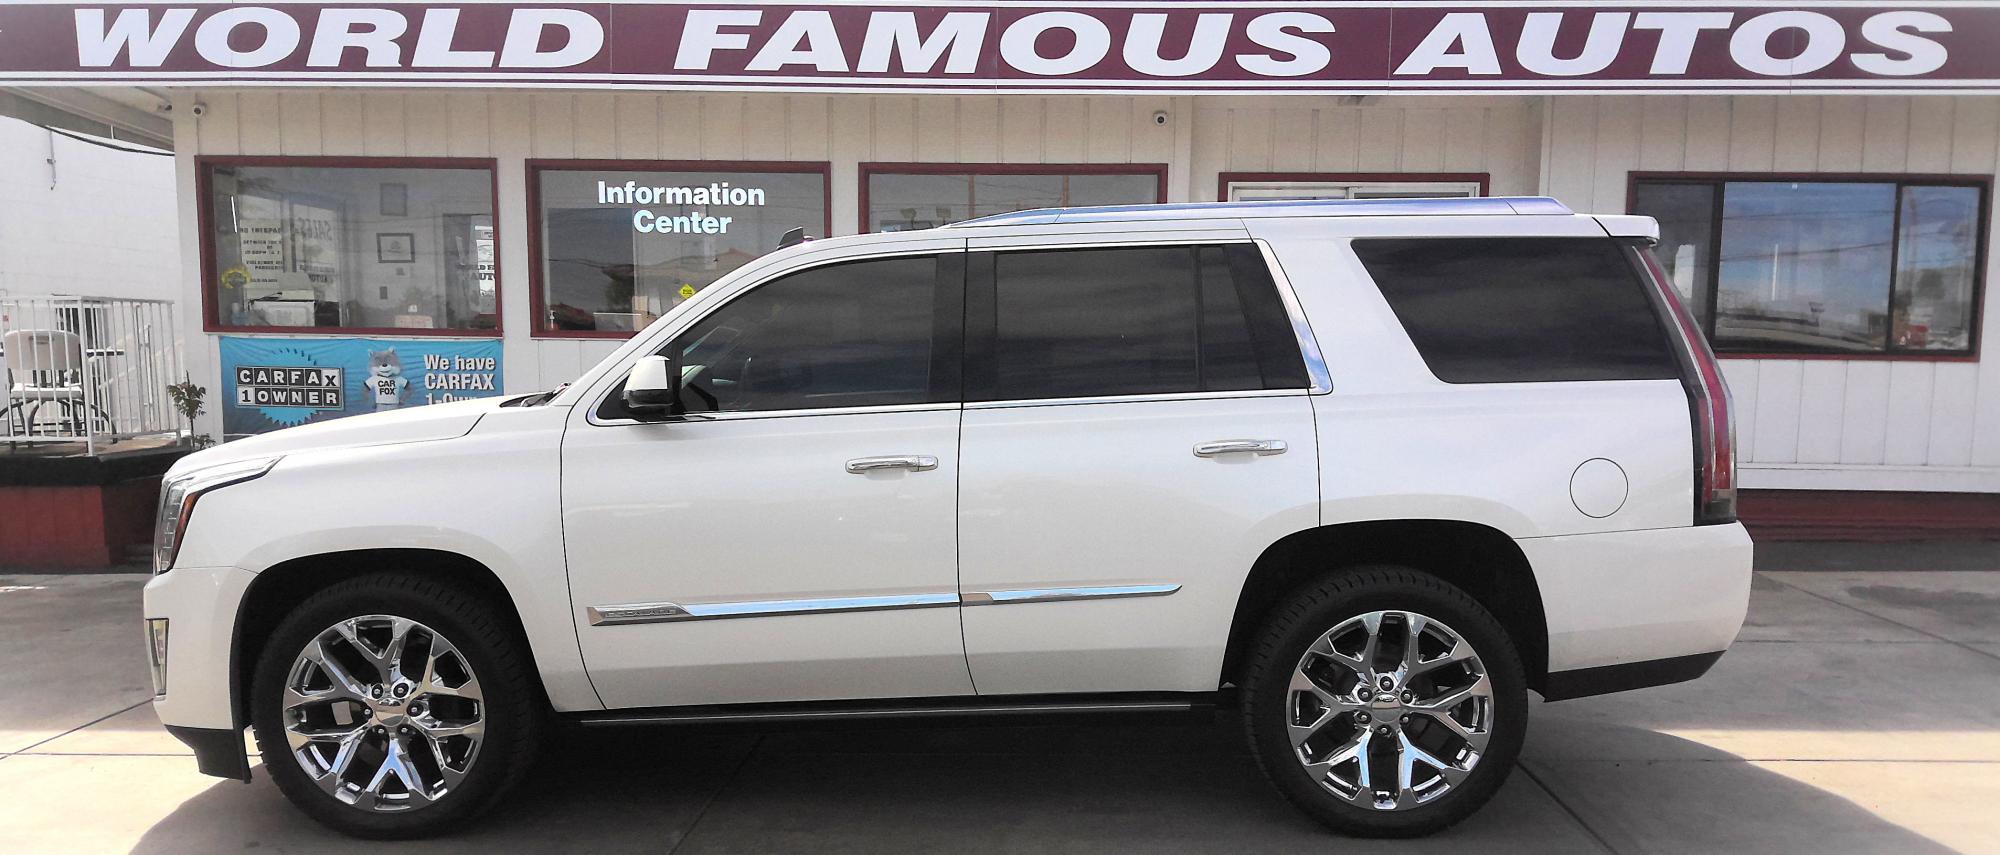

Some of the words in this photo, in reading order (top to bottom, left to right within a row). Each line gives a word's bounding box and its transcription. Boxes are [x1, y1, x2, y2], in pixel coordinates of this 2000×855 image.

[75, 7, 606, 69] WORLD
[673, 8, 1336, 76] FAMOUS
[1393, 9, 1954, 77] AUTOS
[598, 181, 766, 206] Information
[633, 210, 733, 234] Center
[424, 354, 450, 370] We
[455, 354, 496, 371] have
[240, 368, 337, 387] CARFAX
[377, 379, 396, 388] CAR
[425, 373, 496, 390] CARFAX
[379, 387, 395, 396] FOX
